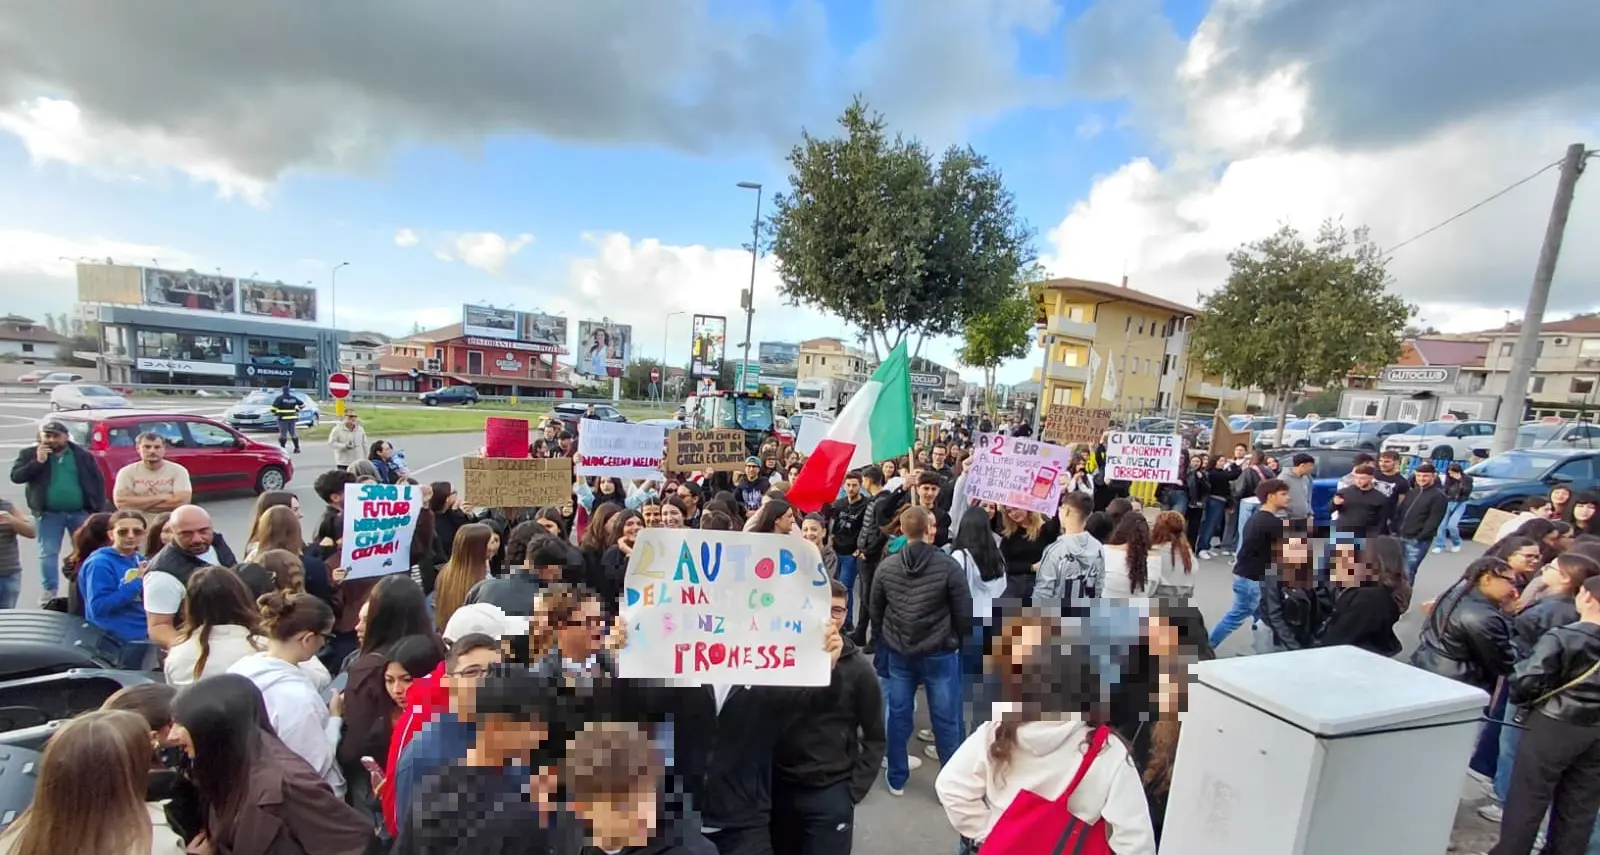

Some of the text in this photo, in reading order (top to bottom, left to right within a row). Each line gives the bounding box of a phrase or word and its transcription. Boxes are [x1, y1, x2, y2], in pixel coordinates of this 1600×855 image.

[144, 361, 192, 370] DACIA
[257, 368, 294, 376] RENAULT
[980, 434, 989, 448] A
[990, 435, 1005, 456] 2
[1111, 434, 1123, 444] CI
[1128, 434, 1173, 447] VOLETE
[970, 465, 1012, 480] ALMENO
[1113, 466, 1171, 481] OBBEDIENTI
[626, 582, 673, 608] DEL
